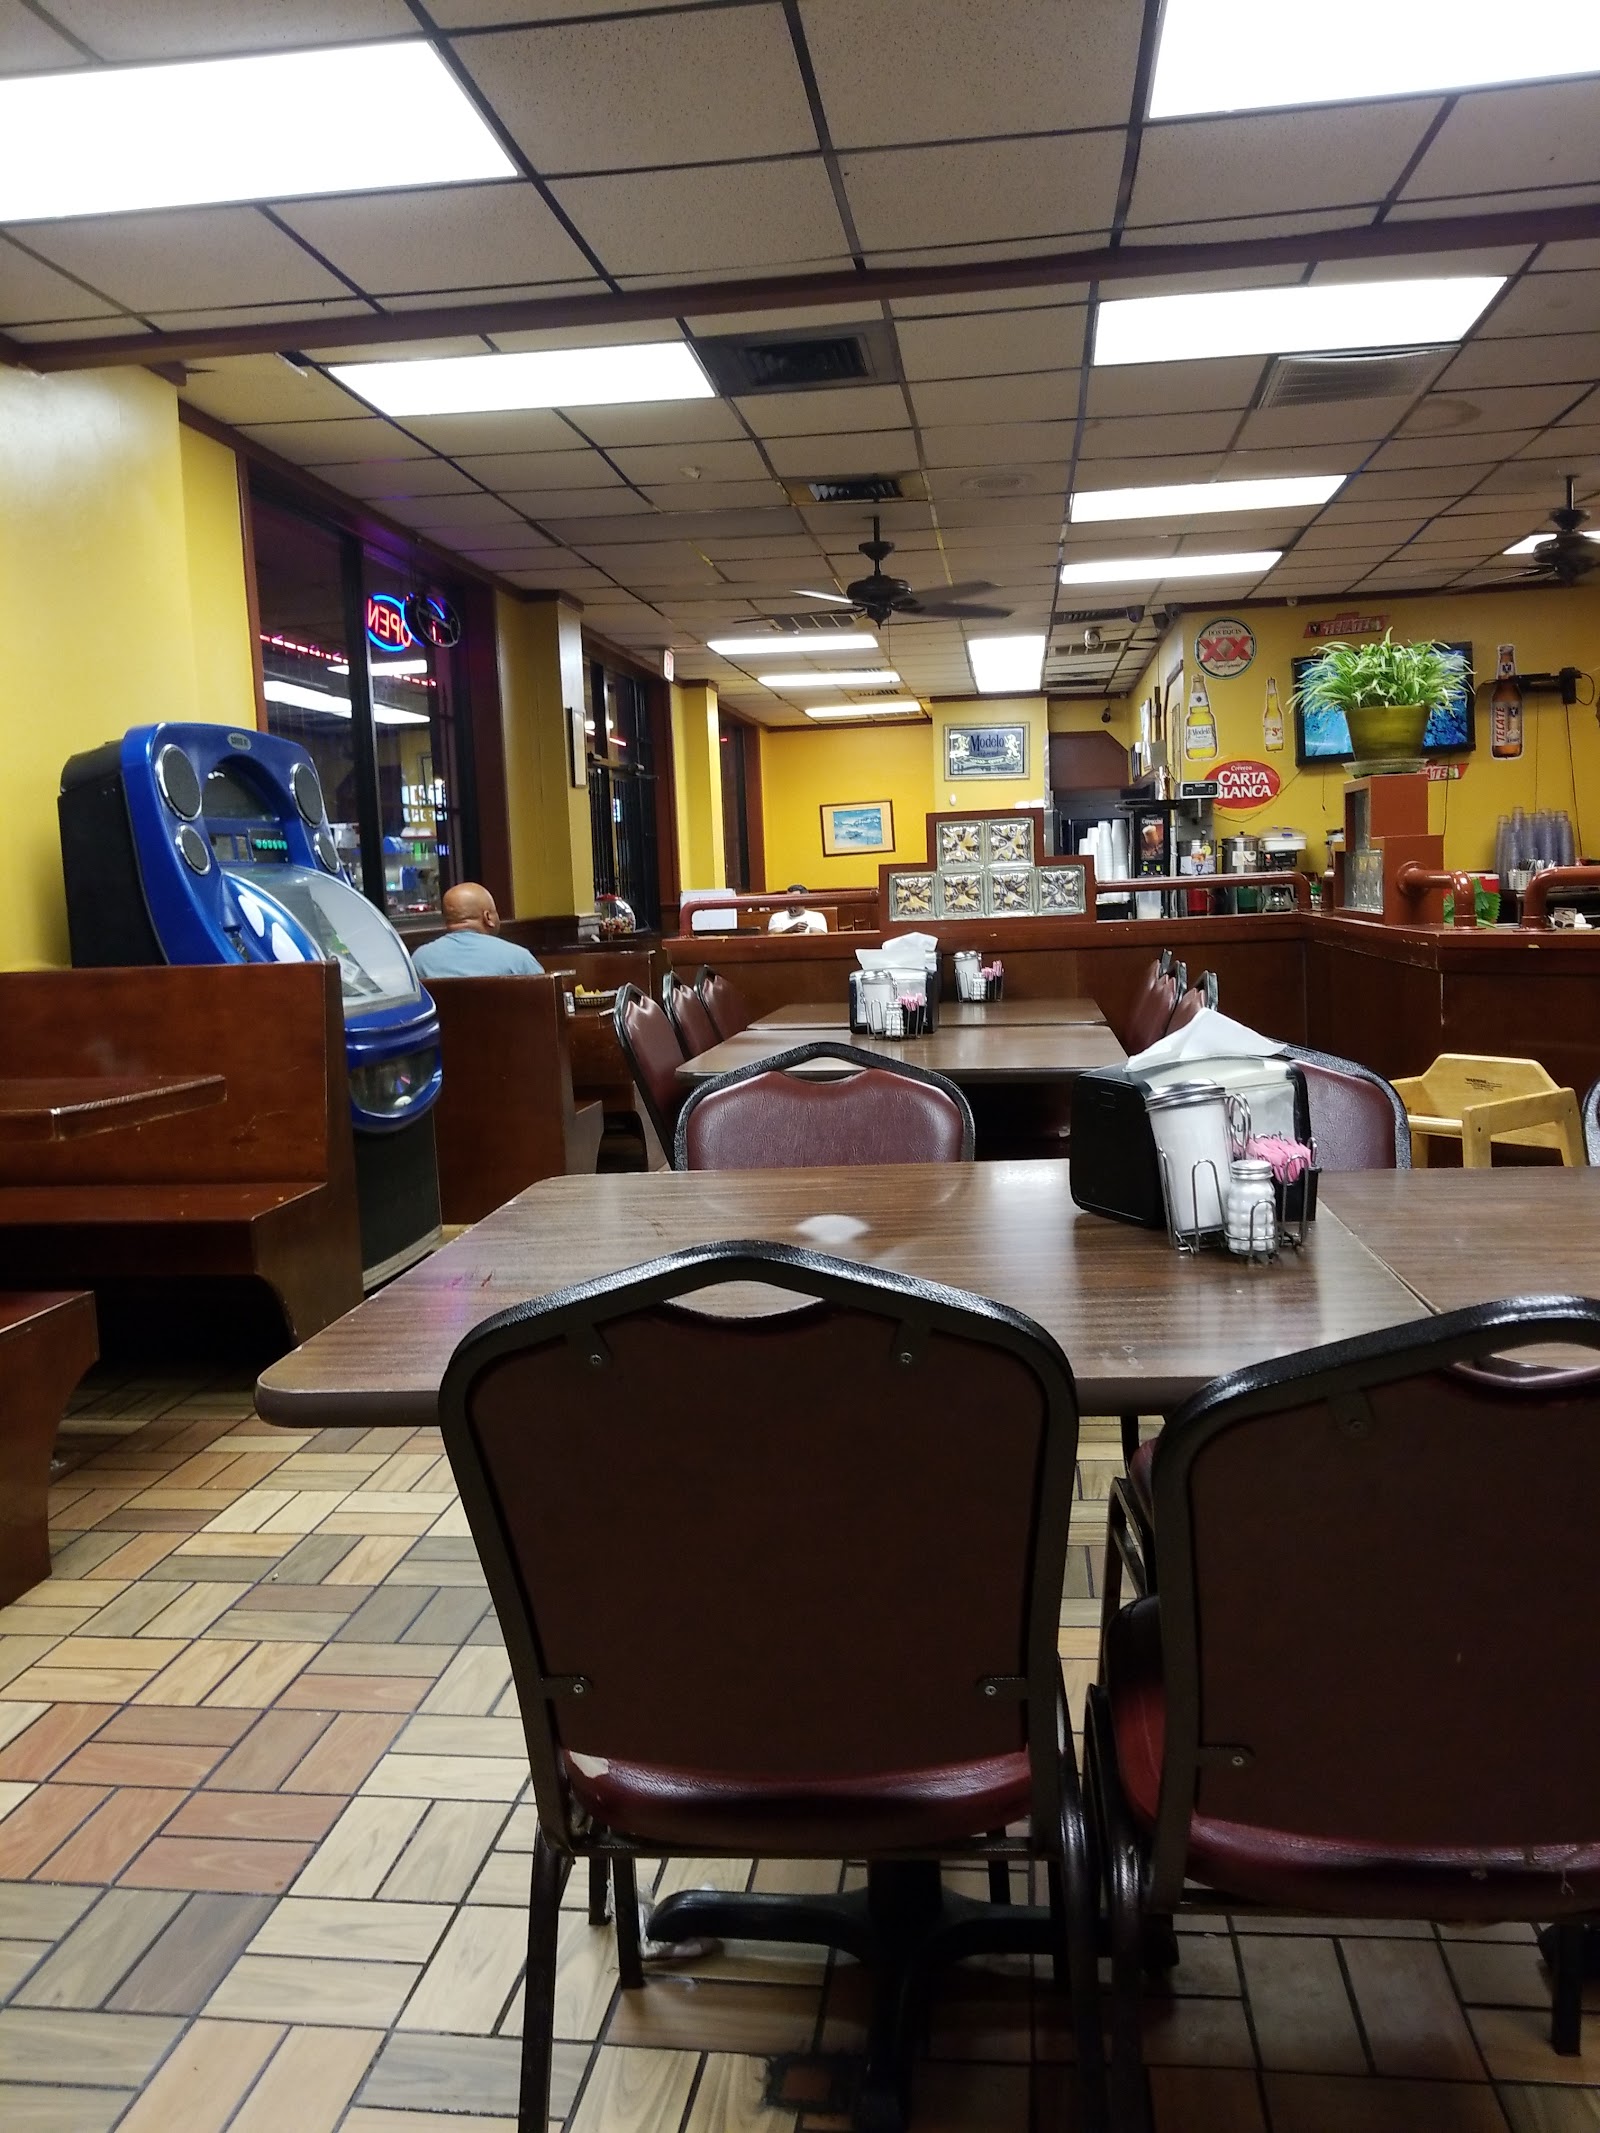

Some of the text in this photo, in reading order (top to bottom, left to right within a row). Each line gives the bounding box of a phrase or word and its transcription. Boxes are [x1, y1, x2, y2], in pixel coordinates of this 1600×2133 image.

[1222, 628, 1242, 636] EQUIS
[1199, 636, 1252, 663] XX
[1496, 706, 1506, 743] TECATE
[970, 735, 1005, 751] Modelo
[1217, 771, 1269, 786] CARTA
[1217, 785, 1273, 799] BLANCA
